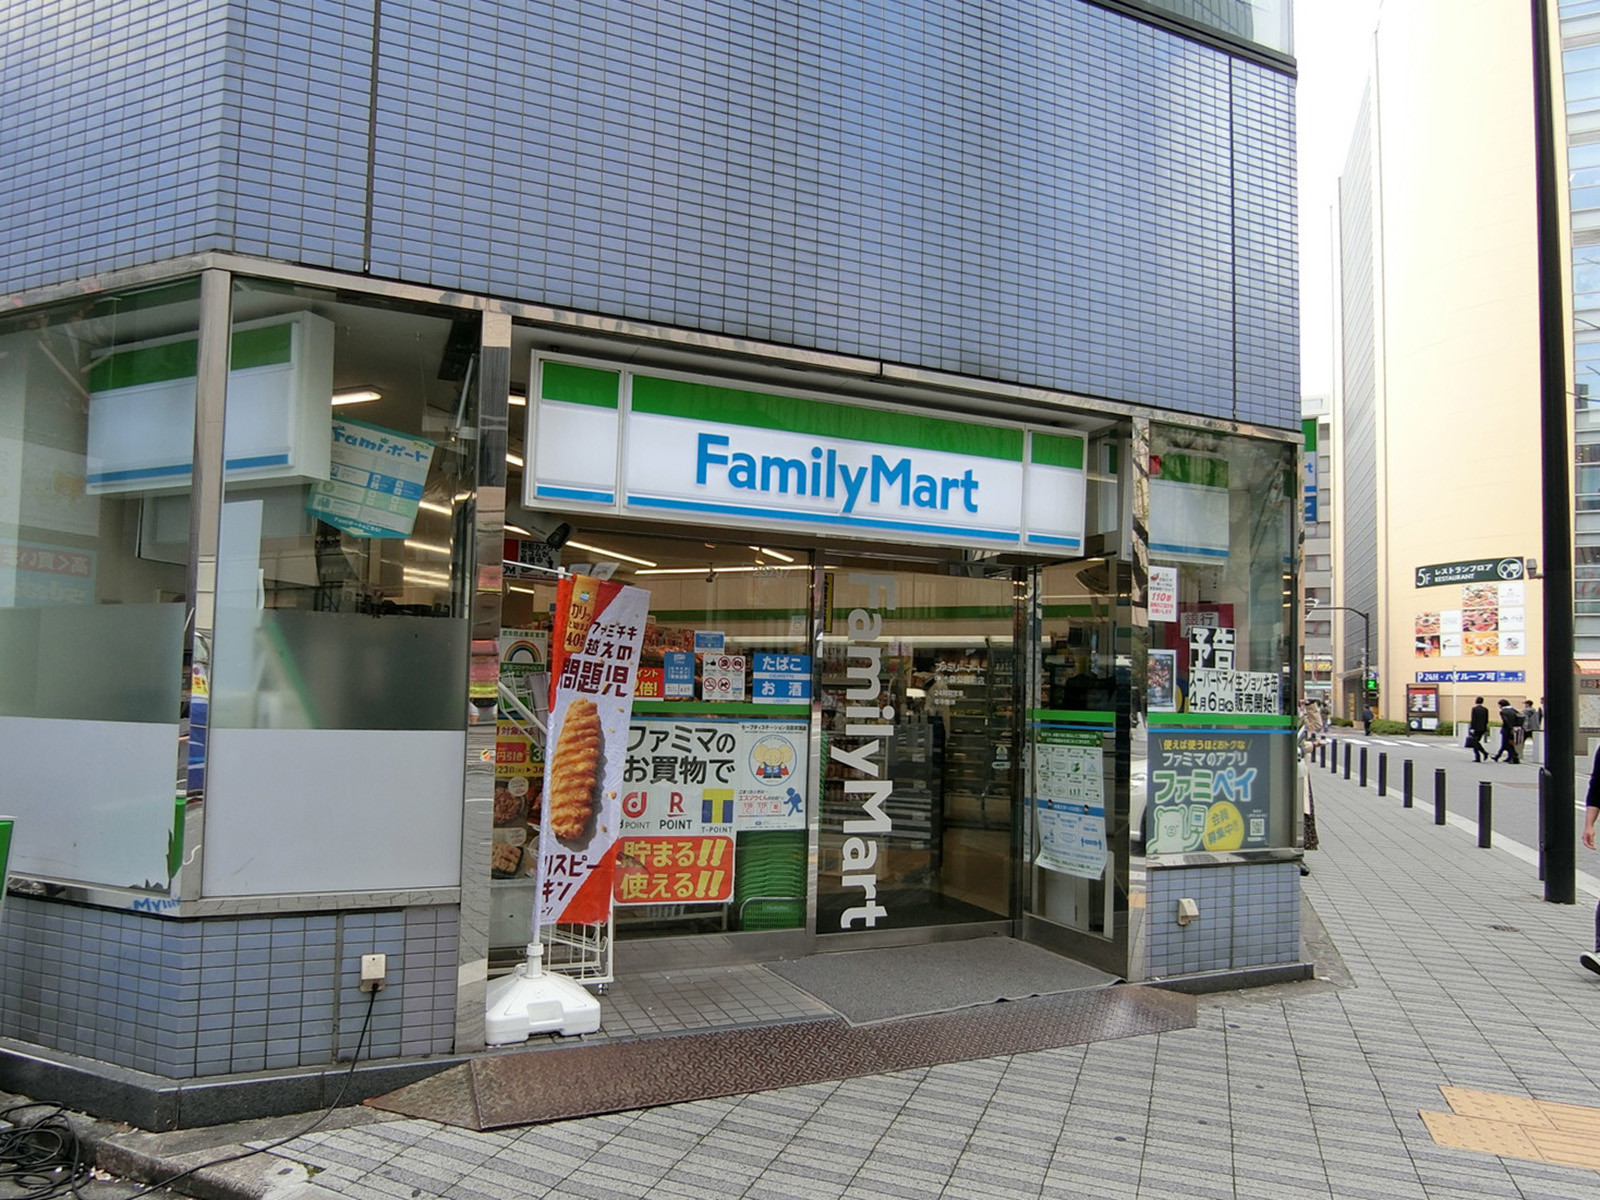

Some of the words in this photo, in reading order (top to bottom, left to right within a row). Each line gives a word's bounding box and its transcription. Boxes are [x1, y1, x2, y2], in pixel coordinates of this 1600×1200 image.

[696, 432, 979, 514] FamilyMart
[1416, 568, 1431, 586] 5F
[1434, 563, 1493, 576] レストランフロア
[1434, 573, 1475, 582] RESTAURANT
[1185, 613, 1214, 626] 銀行
[592, 622, 638, 640] ファミチキ
[584, 638, 633, 661] 越えの
[1190, 627, 1236, 670] 予告
[762, 655, 802, 671] たばこ
[935, 661, 988, 673] ファミリーマート
[560, 657, 629, 697] 問題児
[761, 681, 802, 697] お酒
[626, 725, 736, 754] ファミマの
[1163, 739, 1246, 750] 使えば使うほどおトクな
[829, 573, 896, 930] FamilyMart
[1162, 751, 1248, 767] ファミマのアプリ
[623, 755, 736, 785] お買物で
[1153, 767, 1258, 804] ファミペイ
[625, 821, 651, 829] POINT
[659, 819, 692, 830] POINT
[701, 826, 733, 834] T-POINT
[623, 839, 727, 868] 貯まる!!
[542, 879, 573, 903] キン
[620, 870, 725, 899] 使える!!
